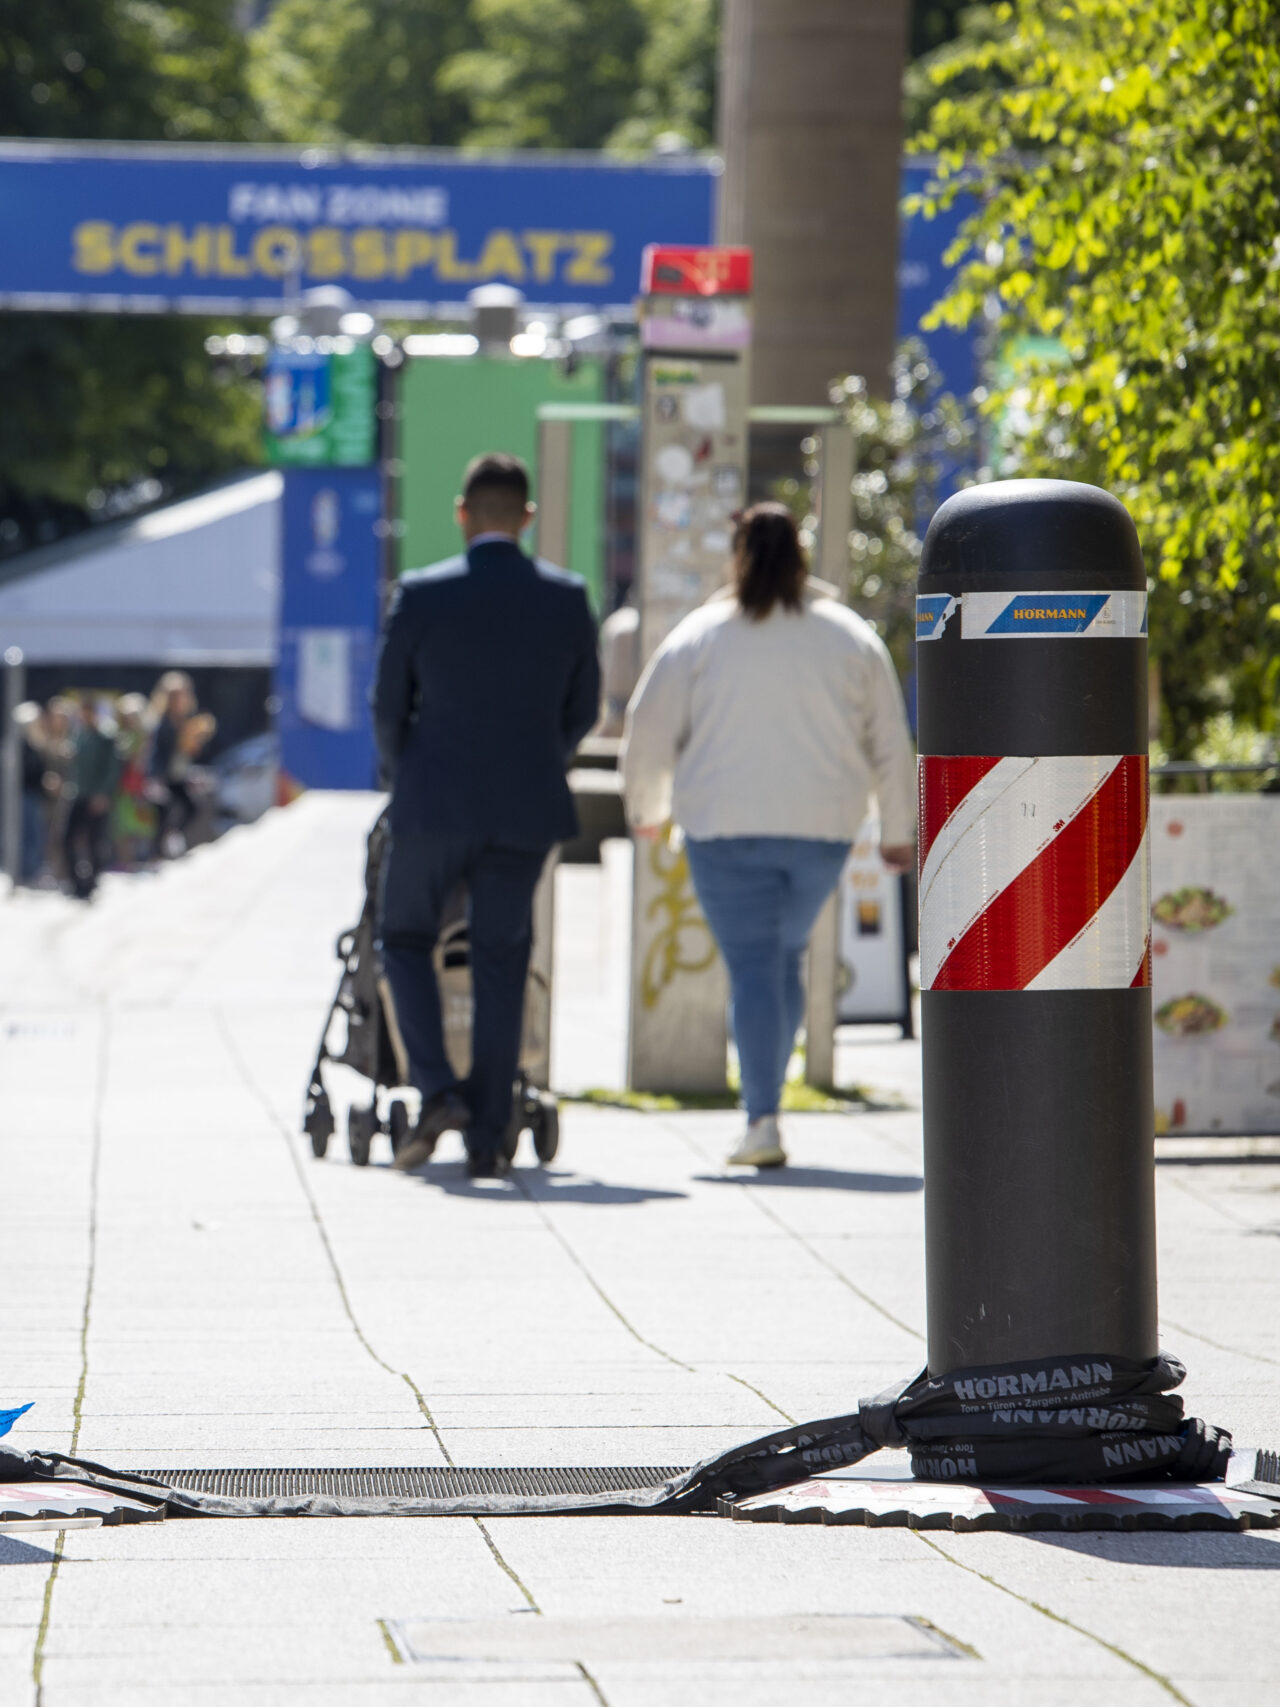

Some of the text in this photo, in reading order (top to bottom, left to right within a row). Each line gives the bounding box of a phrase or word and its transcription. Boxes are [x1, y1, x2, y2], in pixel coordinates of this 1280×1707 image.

[229, 181, 449, 226] FAN ZONE
[73, 219, 615, 285] SCHLOSSPLATZ
[1052, 818, 1066, 832] 3M
[953, 1361, 1113, 1400] HÖRMANN
[960, 1387, 1112, 1413] Tore Türen Zargen Antriebe
